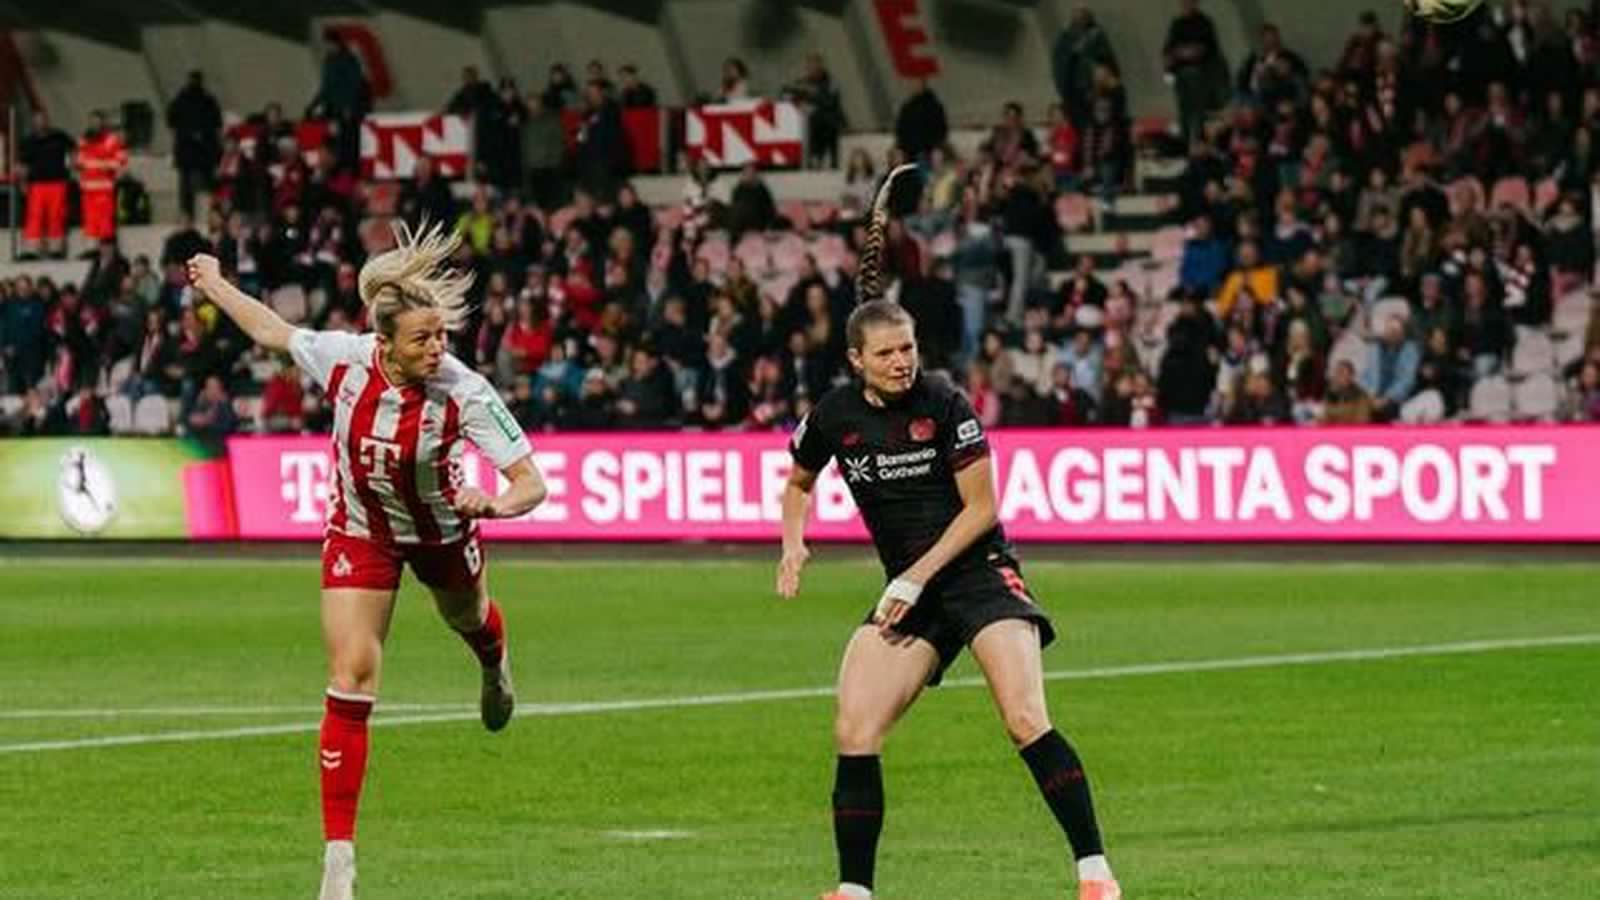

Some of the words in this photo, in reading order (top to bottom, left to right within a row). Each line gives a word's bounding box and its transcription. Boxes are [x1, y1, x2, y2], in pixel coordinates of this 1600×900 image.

[360, 437, 401, 479] T
[582, 451, 794, 522] SPIELE
[1305, 444, 1557, 521] SPORT
